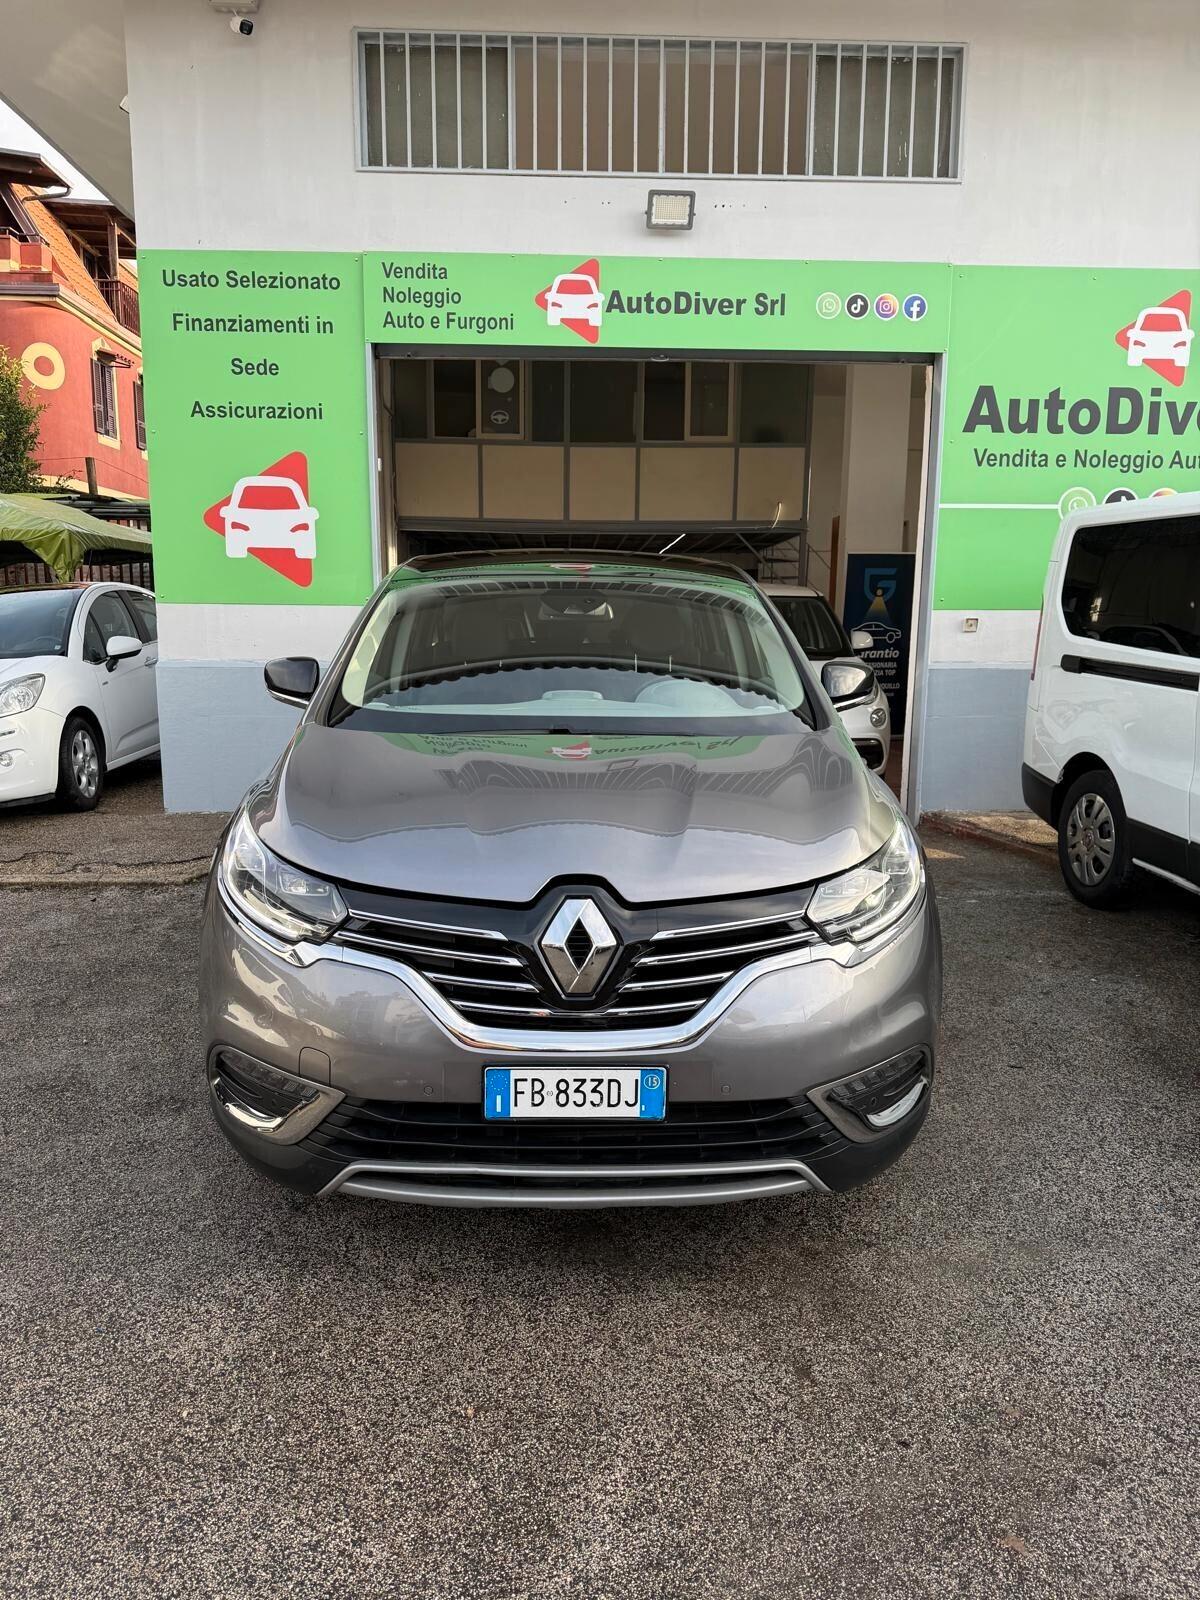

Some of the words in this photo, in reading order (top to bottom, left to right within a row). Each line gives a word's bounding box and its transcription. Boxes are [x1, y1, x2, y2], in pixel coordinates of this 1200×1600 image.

[162, 269, 220, 288] Usato
[225, 269, 341, 291] Selezionato
[381, 261, 448, 280] Vendita
[382, 286, 462, 308] Noleggio
[605, 289, 747, 316] AutoDiver
[754, 292, 786, 317] Srl
[172, 312, 310, 334] Finanziamenti
[316, 315, 334, 334] in
[382, 310, 425, 329] Auto
[430, 315, 440, 329] e
[446, 311, 514, 335] Furgoni
[230, 357, 280, 376] Sede
[190, 400, 323, 420] Assicurazioni
[962, 385, 1200, 436] AutoDiv
[973, 447, 1049, 468] Vendita
[1055, 453, 1067, 468] e
[1073, 449, 1164, 474] Noleggio
[857, 647, 900, 658] rantio
[513, 1077, 545, 1108] FB
[555, 1078, 639, 1108] 833DJ
[648, 1076, 658, 1087] 15
